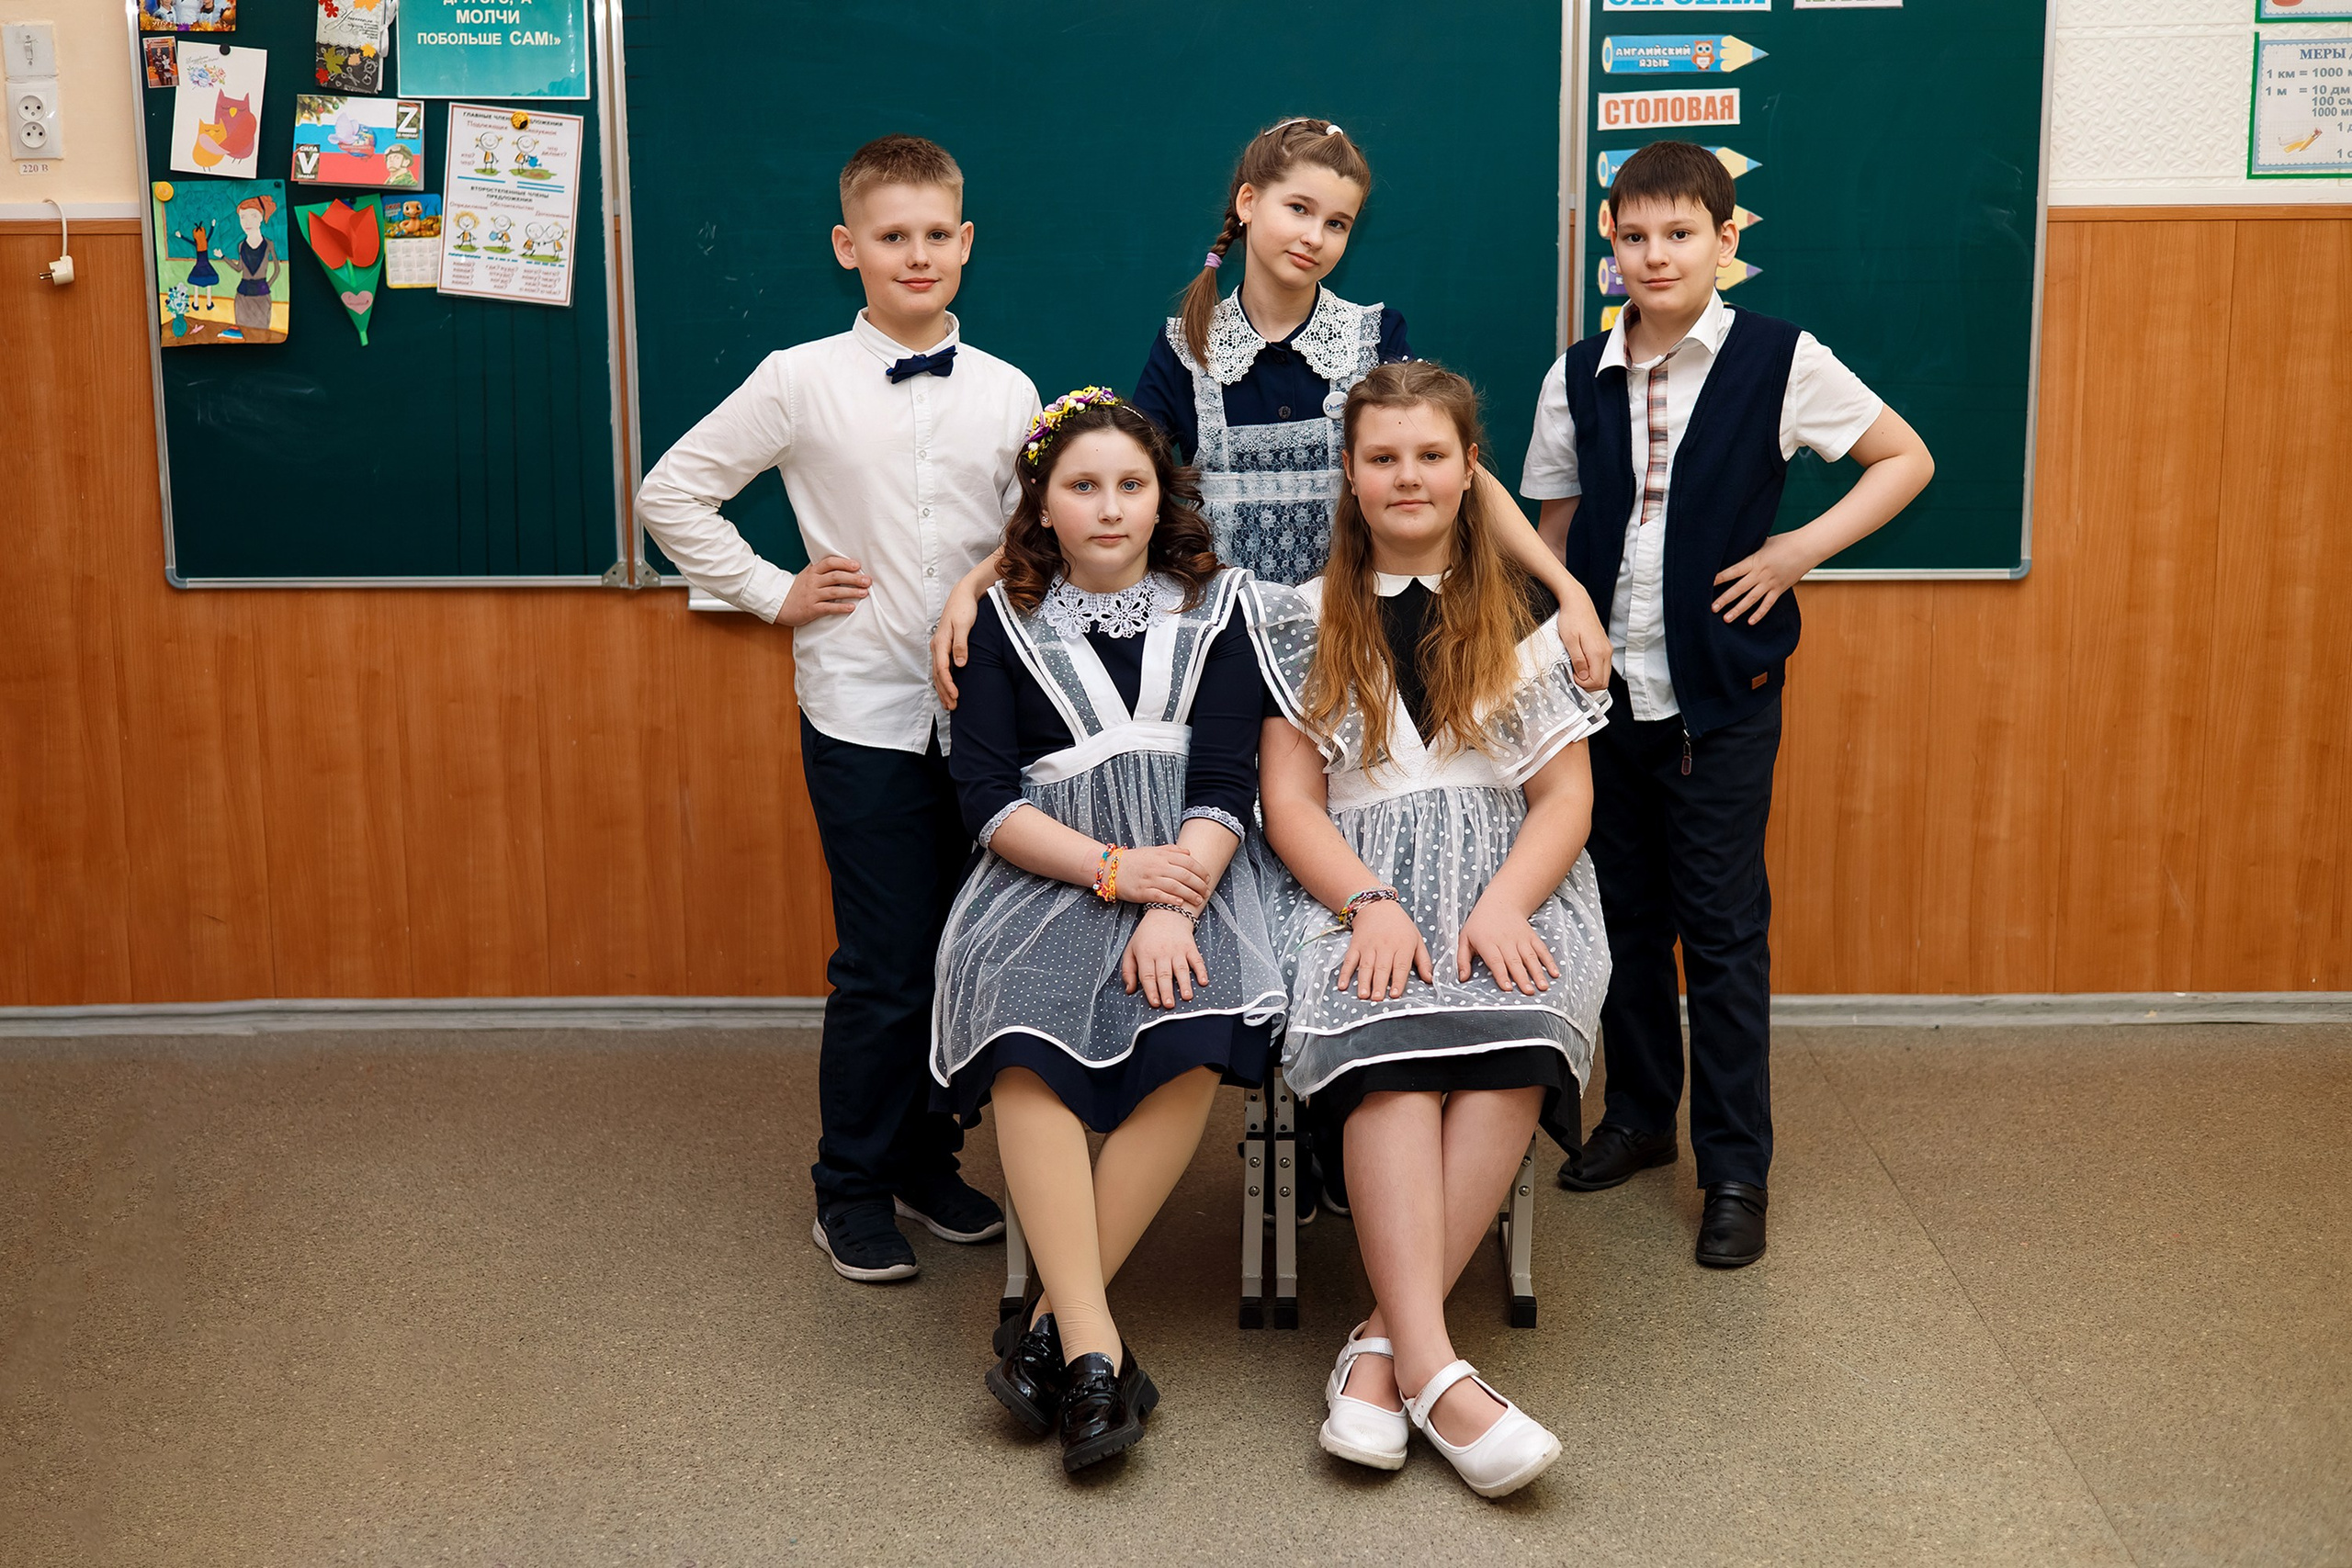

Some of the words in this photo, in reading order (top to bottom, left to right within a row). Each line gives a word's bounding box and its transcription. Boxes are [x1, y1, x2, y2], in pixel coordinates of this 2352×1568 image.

[456, 9, 520, 25] МОЛЧИ
[417, 32, 503, 46] ПОБОЛЬШЕ
[509, 30, 562, 47] САМ!»
[1615, 44, 1691, 57] АНГЛИЙСКИЙ
[2300, 48, 2346, 60] МЕРЫ
[1638, 59, 1670, 68] ЯЗЫК
[2278, 71, 2296, 79] км
[2312, 67, 2344, 78] 1000
[2312, 85, 2327, 96] 10
[2330, 86, 2350, 96] дм
[2312, 96, 2335, 107] 100
[1604, 95, 1735, 125] СТОЛОВАЯ
[2312, 107, 2337, 118] 1000
[398, 107, 419, 133] Z
[22, 164, 39, 173] 220
[297, 152, 321, 175] V
